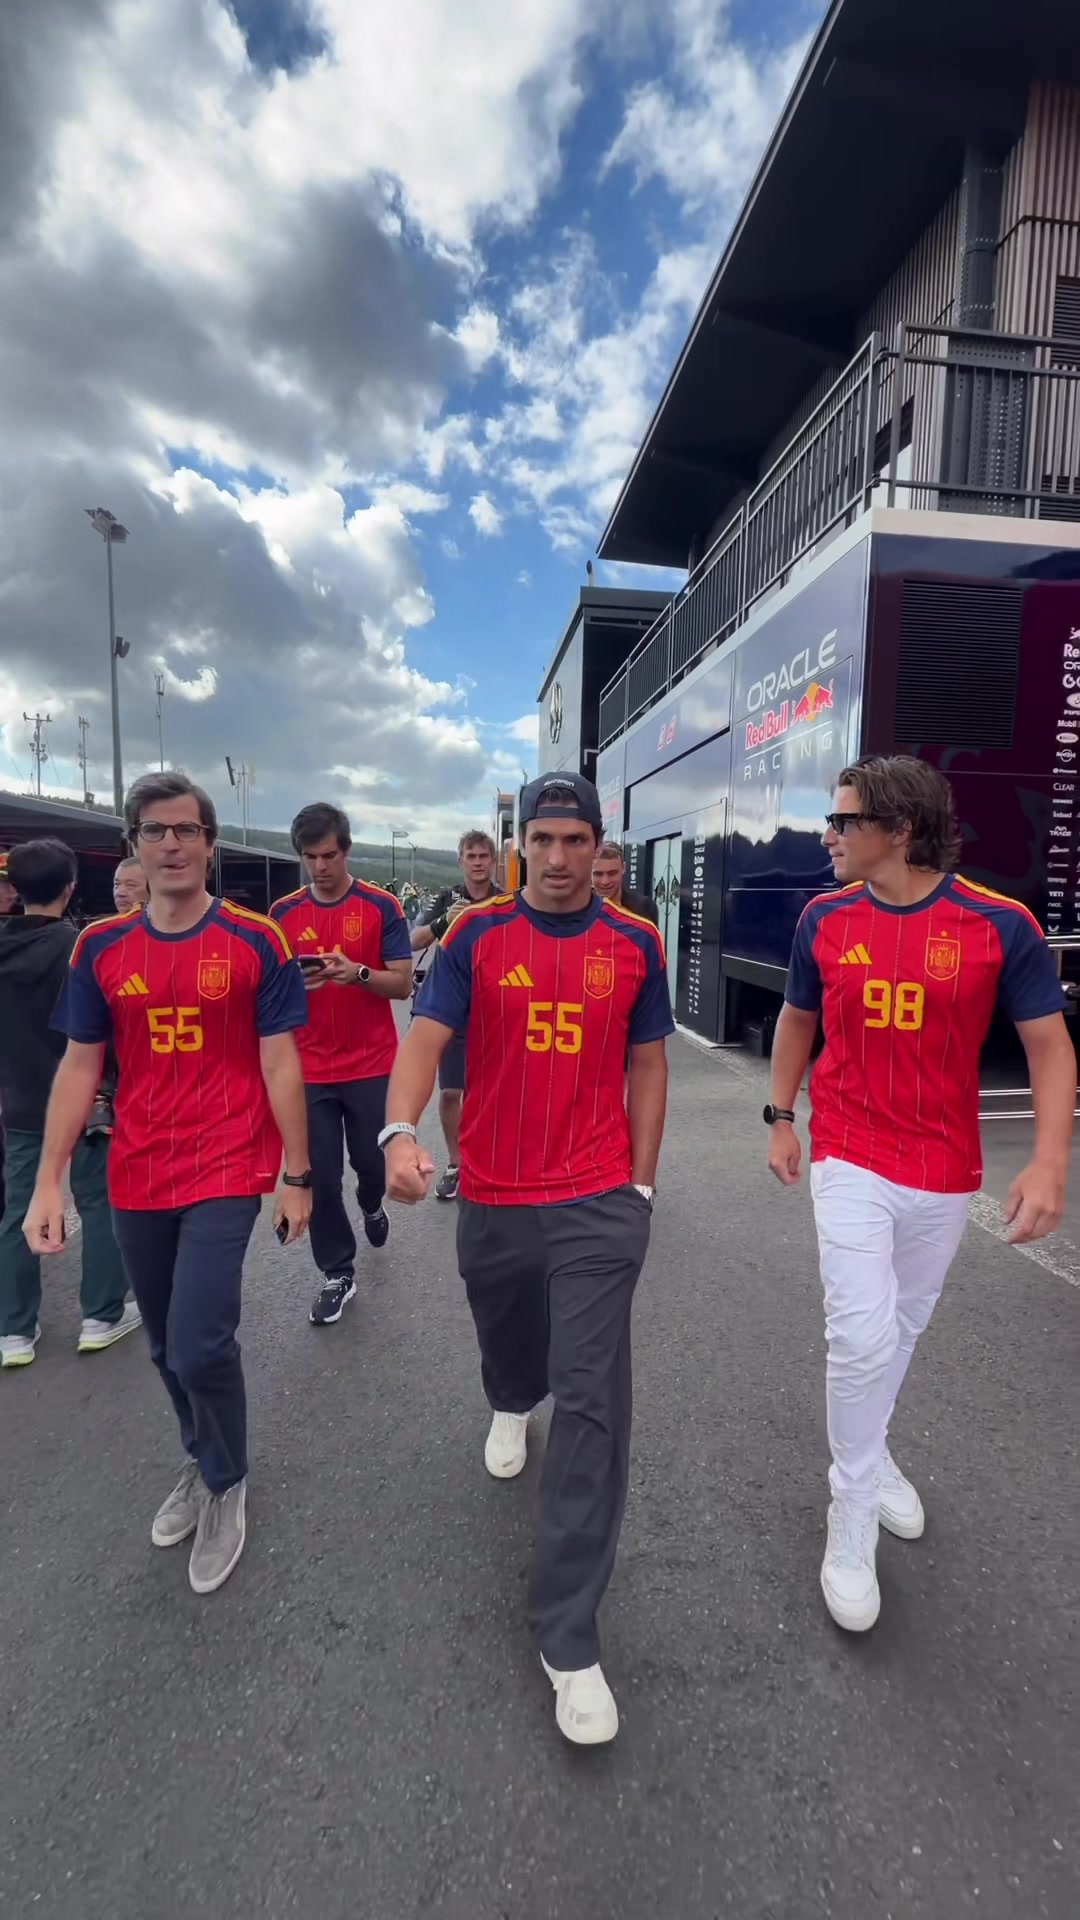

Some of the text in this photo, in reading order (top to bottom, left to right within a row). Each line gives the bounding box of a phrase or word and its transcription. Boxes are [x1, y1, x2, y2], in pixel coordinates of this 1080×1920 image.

[747, 628, 837, 712] ORACLE
[745, 700, 789, 751] Red Bull
[744, 730, 833, 781] RACNG
[147, 1006, 204, 1053] 55
[526, 1001, 583, 1053] 55
[863, 980, 925, 1031] 98
